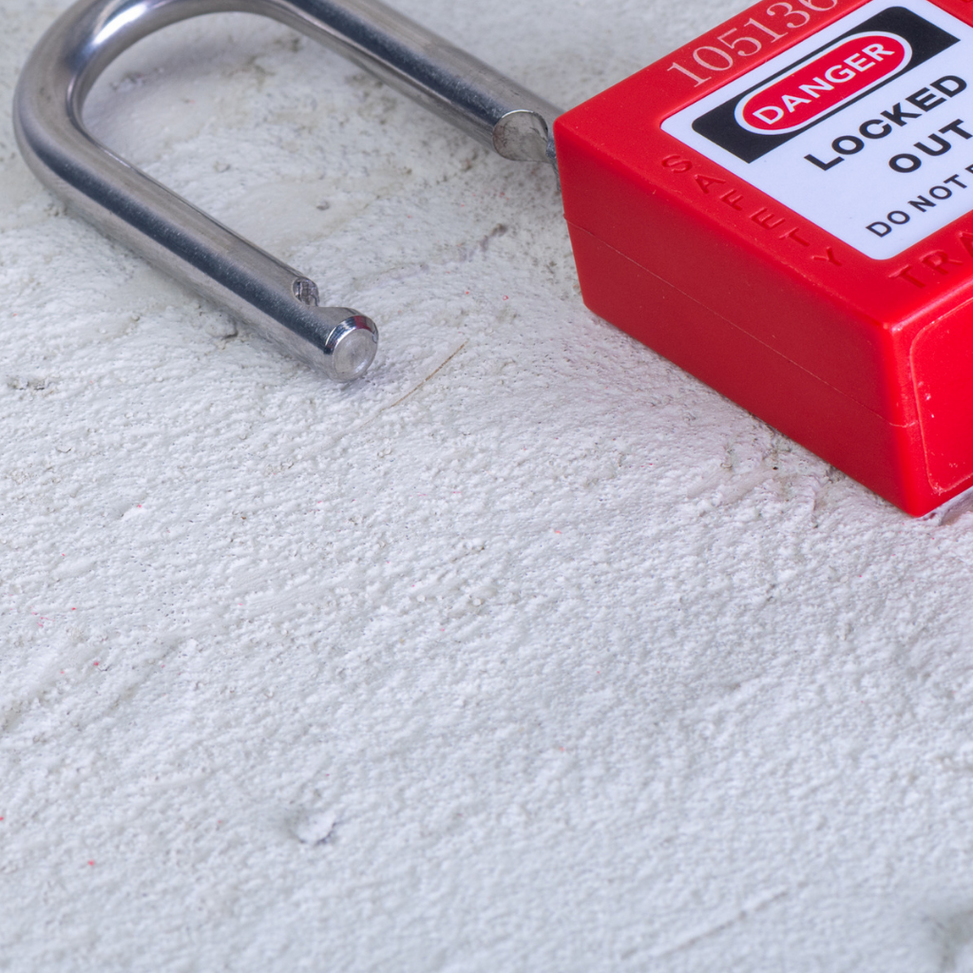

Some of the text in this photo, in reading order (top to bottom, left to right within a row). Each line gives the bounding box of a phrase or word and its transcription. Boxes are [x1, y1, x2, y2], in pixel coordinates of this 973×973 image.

[752, 42, 895, 125] DANGER
[803, 74, 968, 172] LOCKED
[888, 118, 973, 174] OUT
[660, 153, 844, 268] SAFETY
[865, 209, 911, 238] DO
[907, 174, 969, 213] NOT
